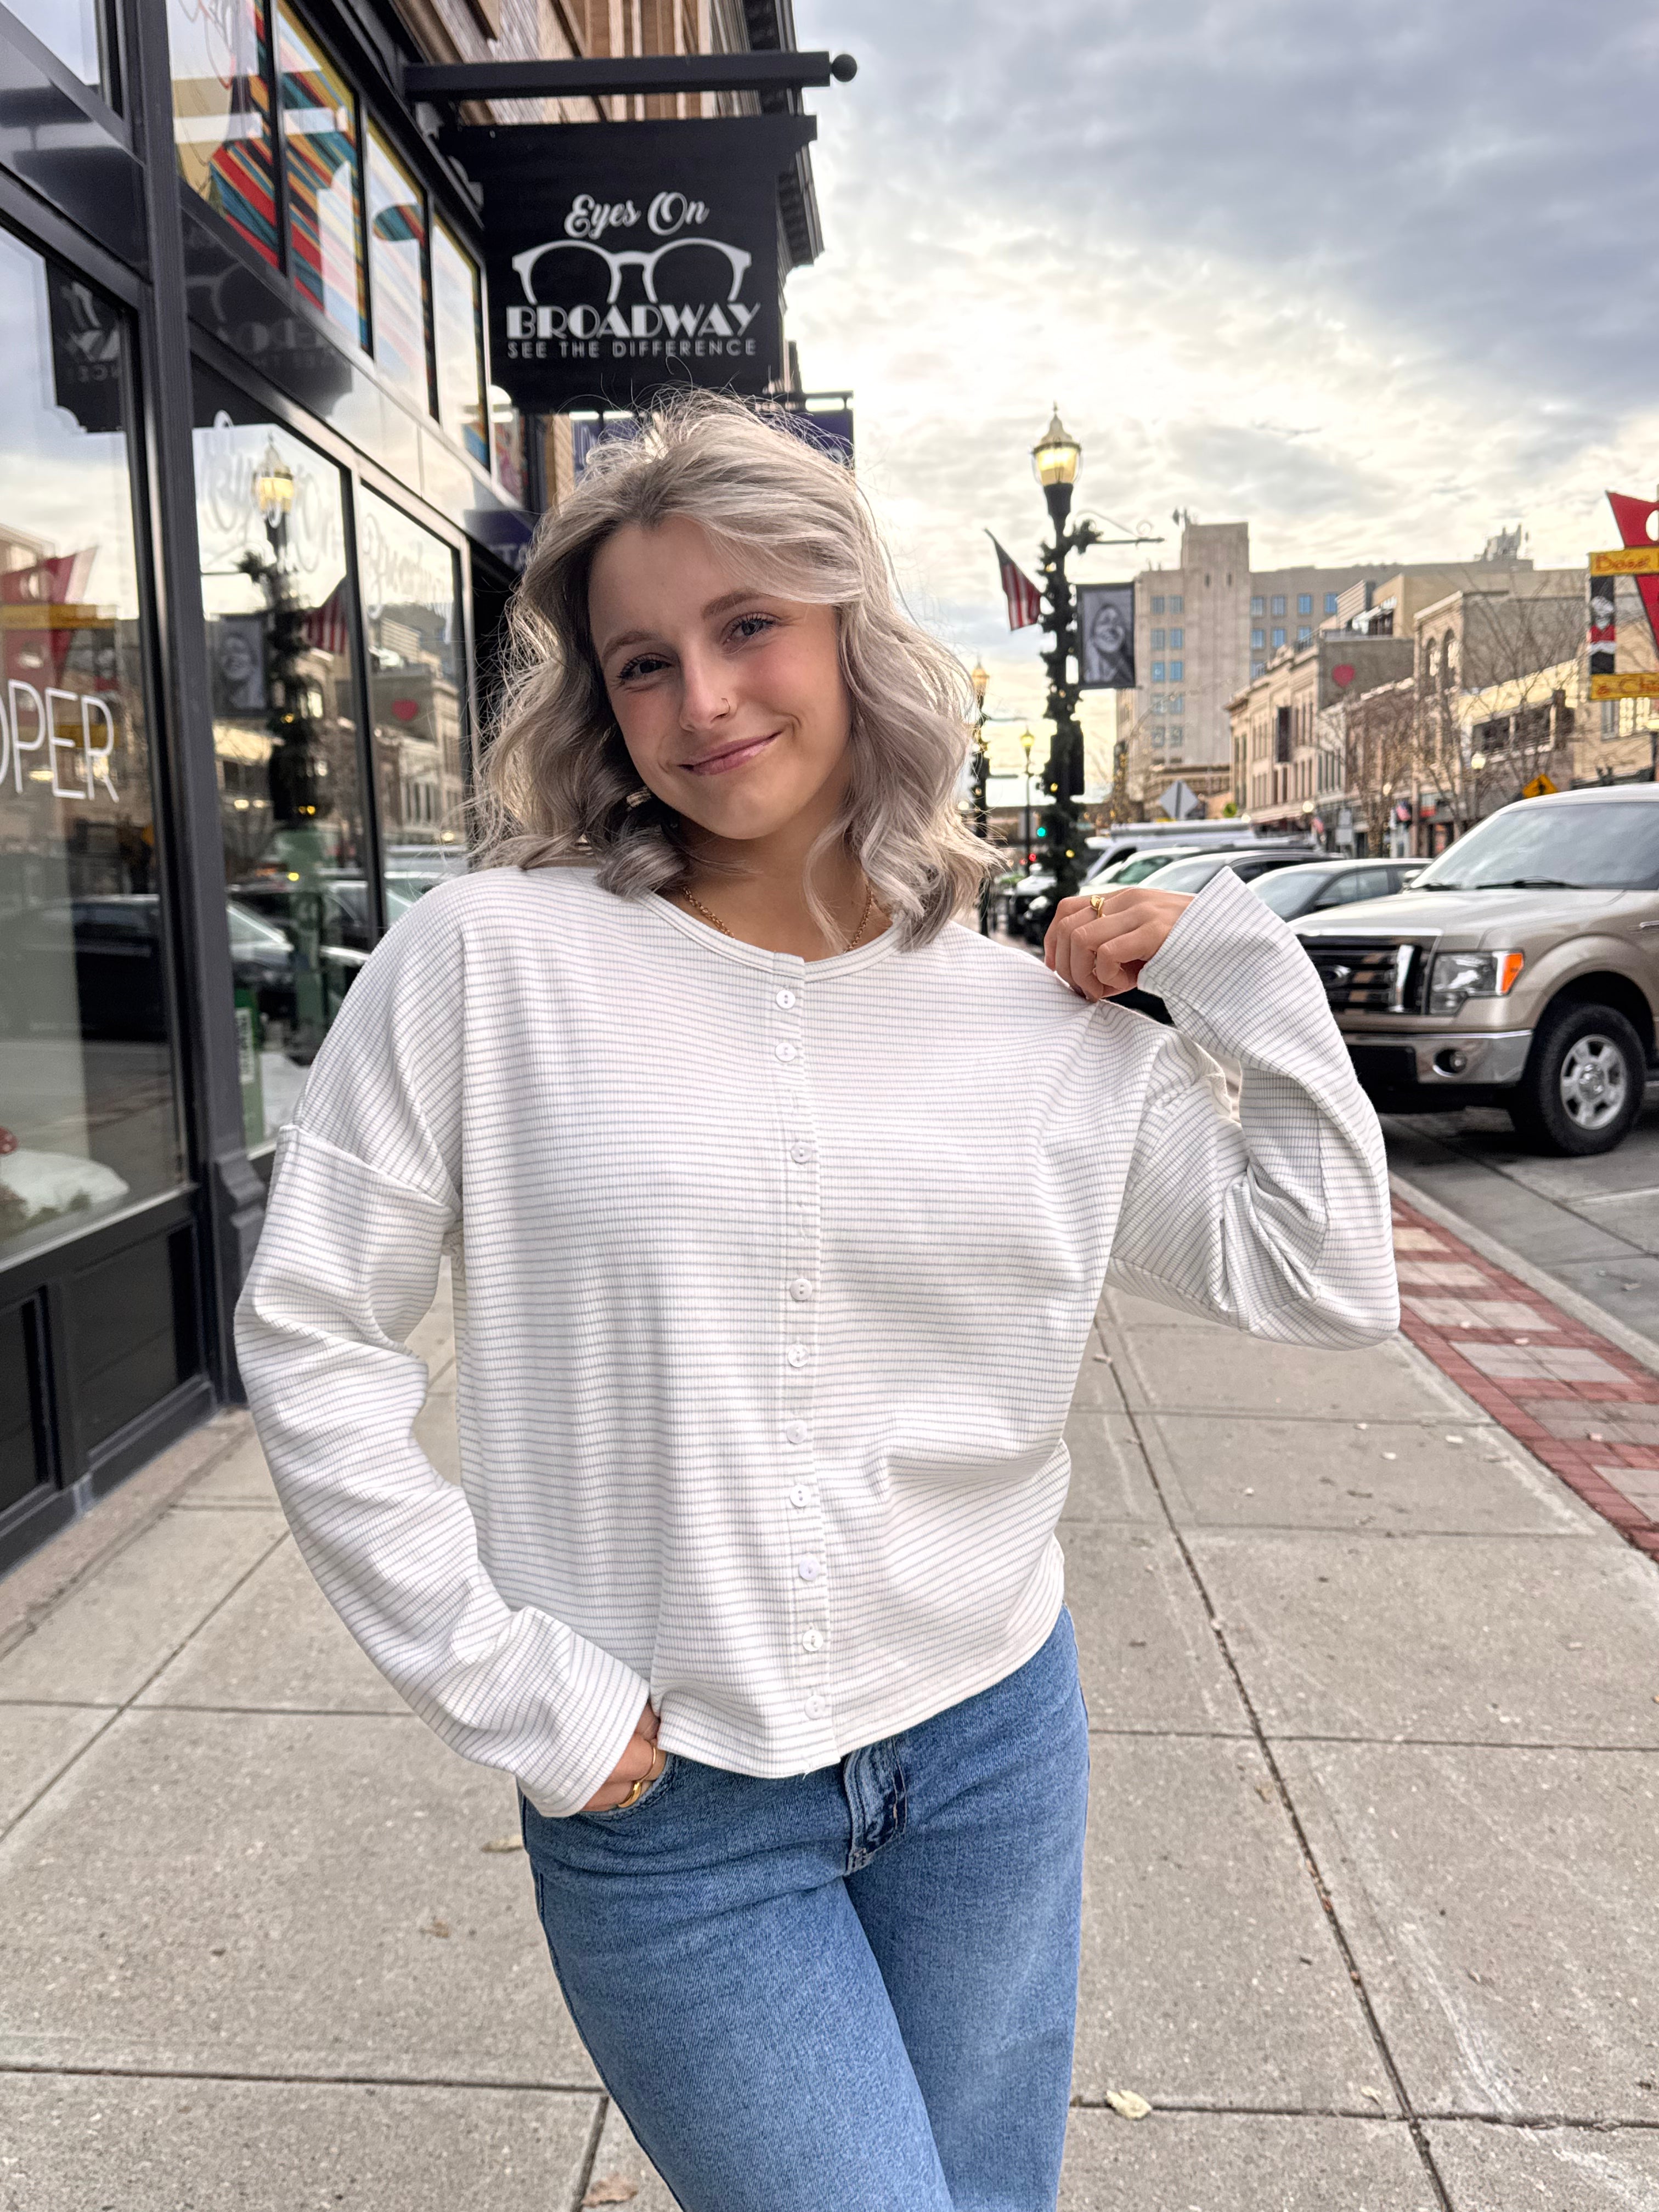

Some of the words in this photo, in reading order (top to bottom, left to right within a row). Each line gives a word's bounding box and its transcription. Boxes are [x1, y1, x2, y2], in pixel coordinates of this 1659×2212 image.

[564, 194, 641, 240] Eyes
[647, 191, 710, 236] On
[506, 303, 761, 339] BROADWAY
[507, 339, 548, 359] SEE
[560, 339, 600, 359] THE
[612, 337, 757, 358] DIFFERENCE
[0, 679, 120, 803] PER
